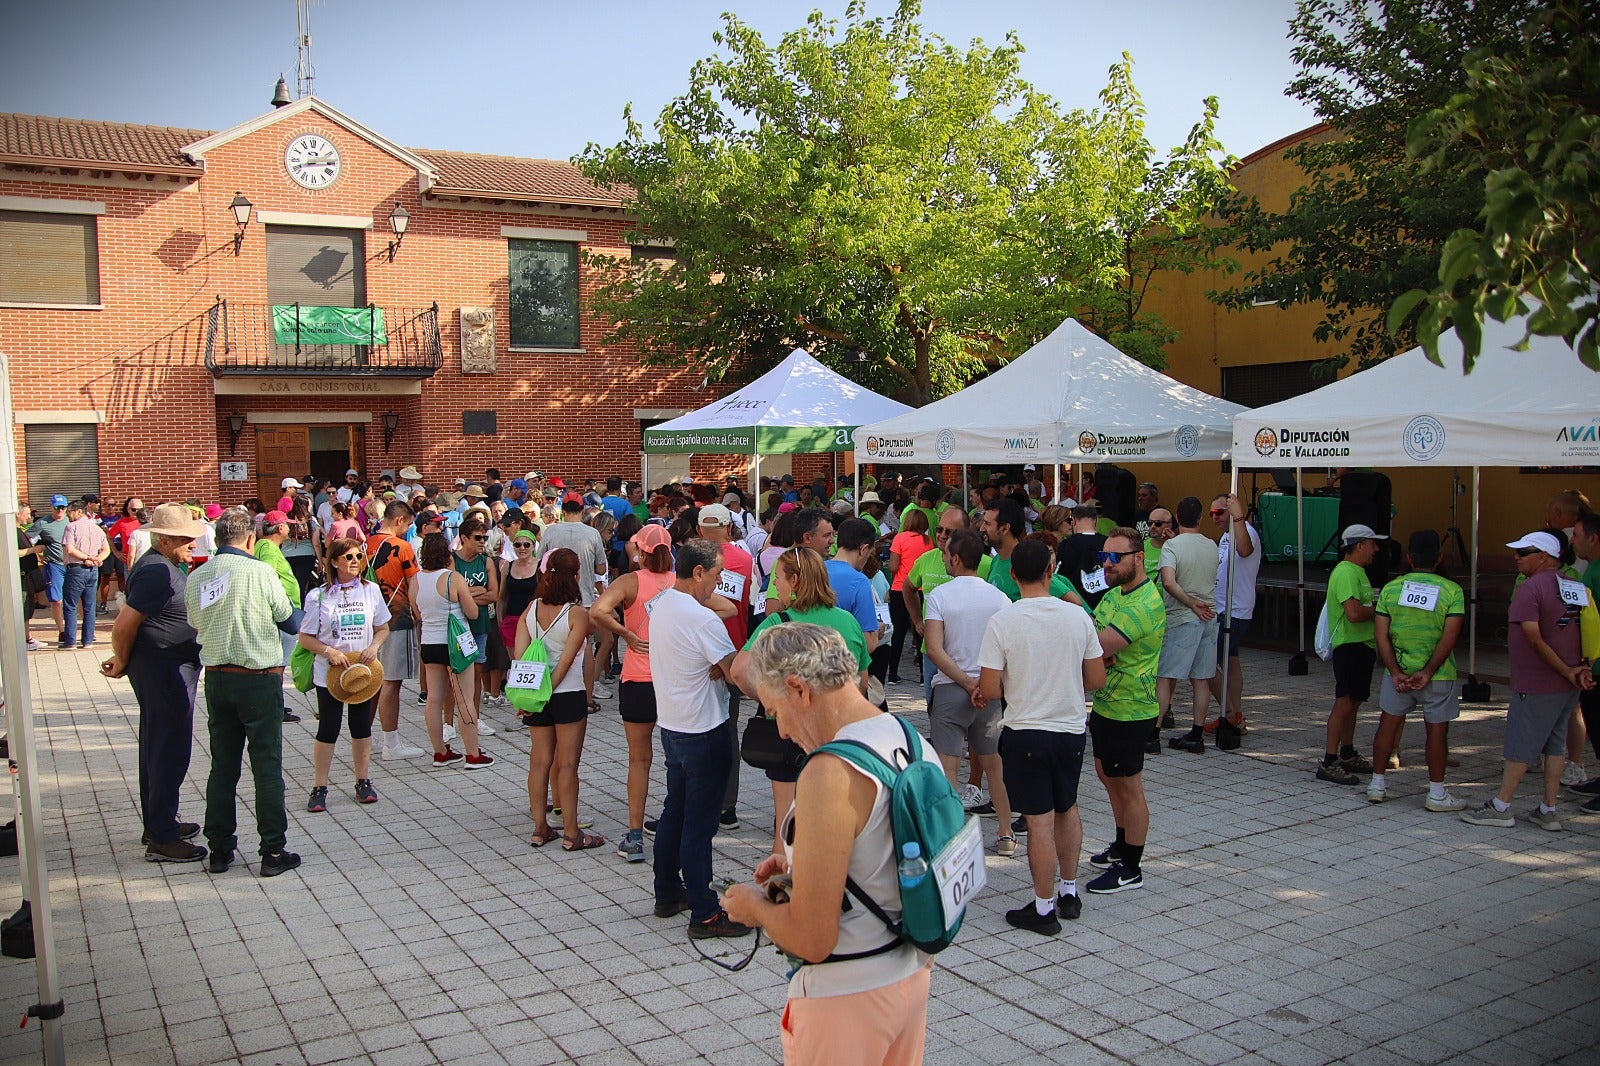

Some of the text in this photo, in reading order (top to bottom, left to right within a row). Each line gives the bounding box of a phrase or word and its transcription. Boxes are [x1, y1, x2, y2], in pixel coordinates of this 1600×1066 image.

[260, 382, 381, 392] CASA CONSISTORIAL
[1098, 433, 1147, 445] DIPUTACIÓN
[1280, 428, 1350, 443] DIPUTACIÓN
[1555, 426, 1600, 442] AVA
[648, 433, 749, 448] Asociación Española contra el Cáncer
[1003, 438, 1040, 449] AVANZA
[886, 449, 914, 458] VALLADOLID
[1097, 446, 1146, 456] DE VALLADOLID
[1280, 446, 1350, 458] DE VALLADOLID
[209, 584, 223, 601] 311
[1407, 593, 1428, 605] 089
[516, 673, 536, 684] 352
[953, 861, 975, 906] 027
